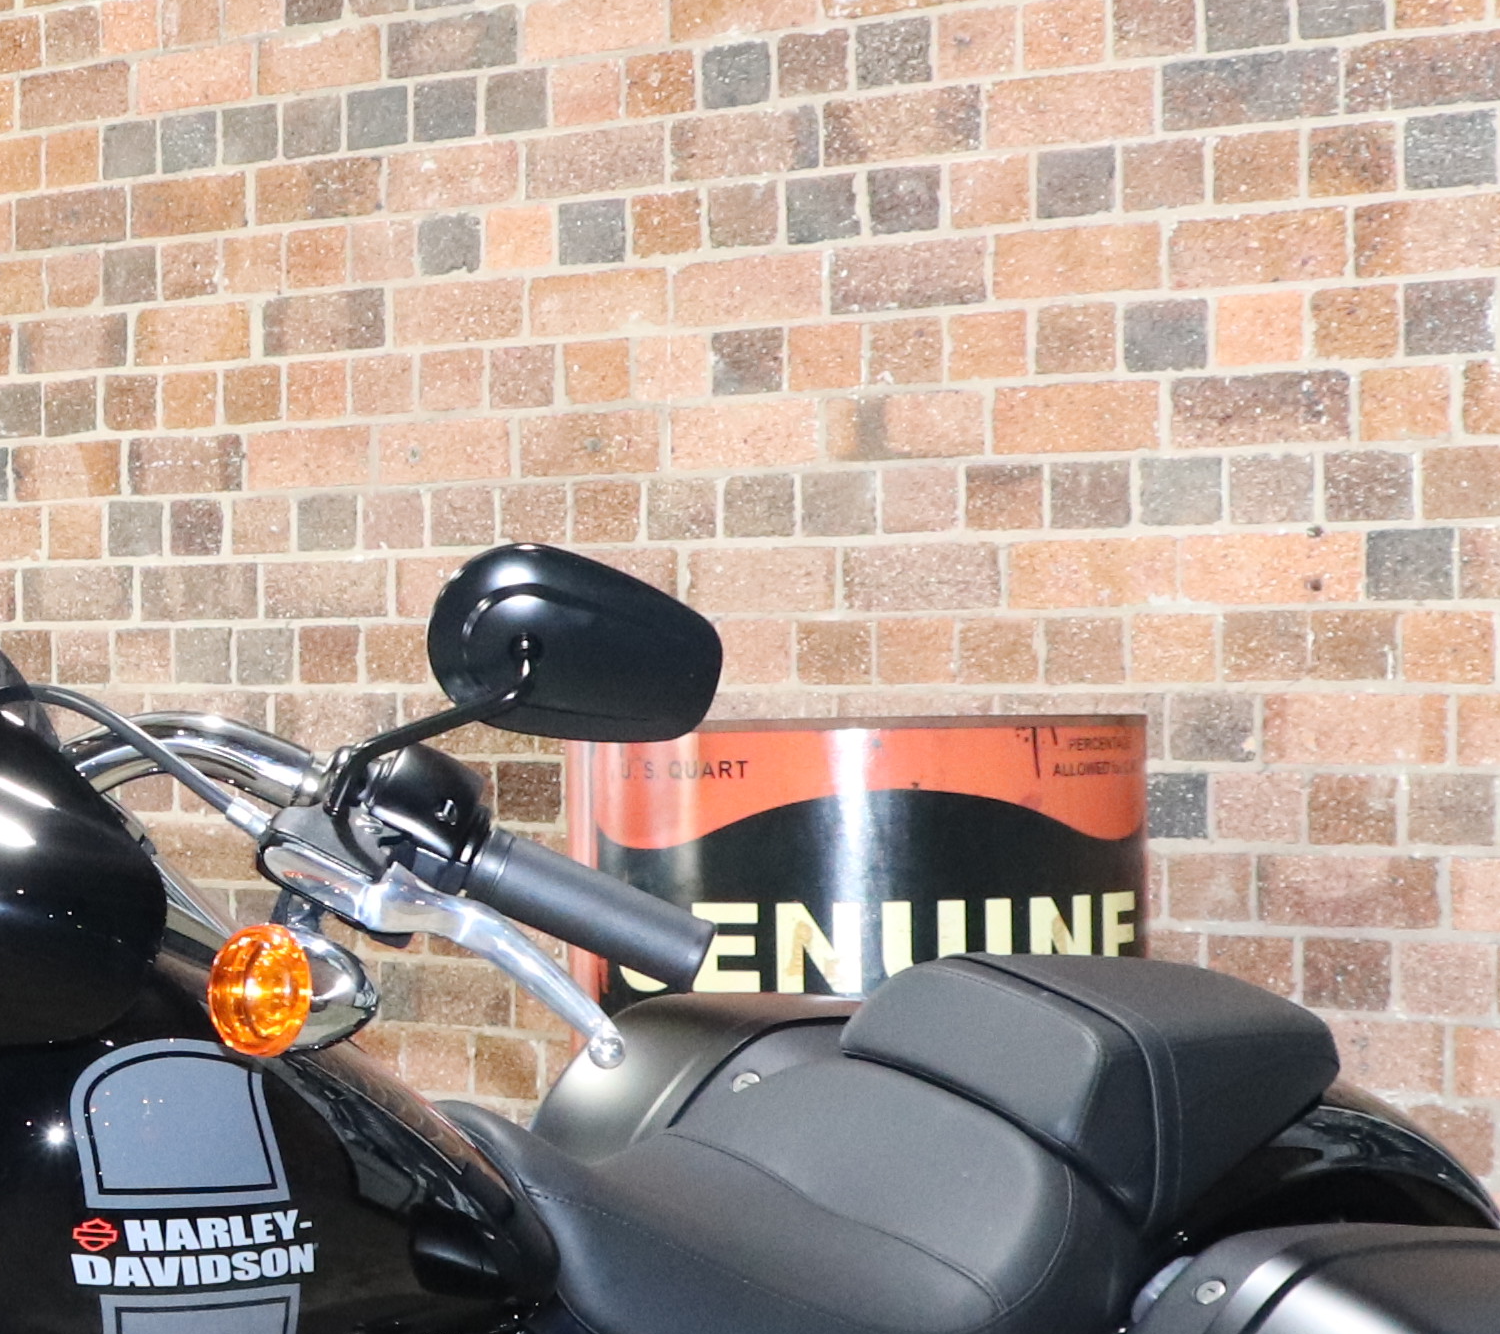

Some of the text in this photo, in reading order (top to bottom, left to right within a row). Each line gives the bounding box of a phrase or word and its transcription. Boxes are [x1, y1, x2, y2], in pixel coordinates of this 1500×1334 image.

[668, 760, 748, 779] QUART
[619, 890, 1135, 993] ENUINE
[123, 1209, 313, 1252] HARLEY-
[70, 1243, 315, 1288] DAVIDSON
